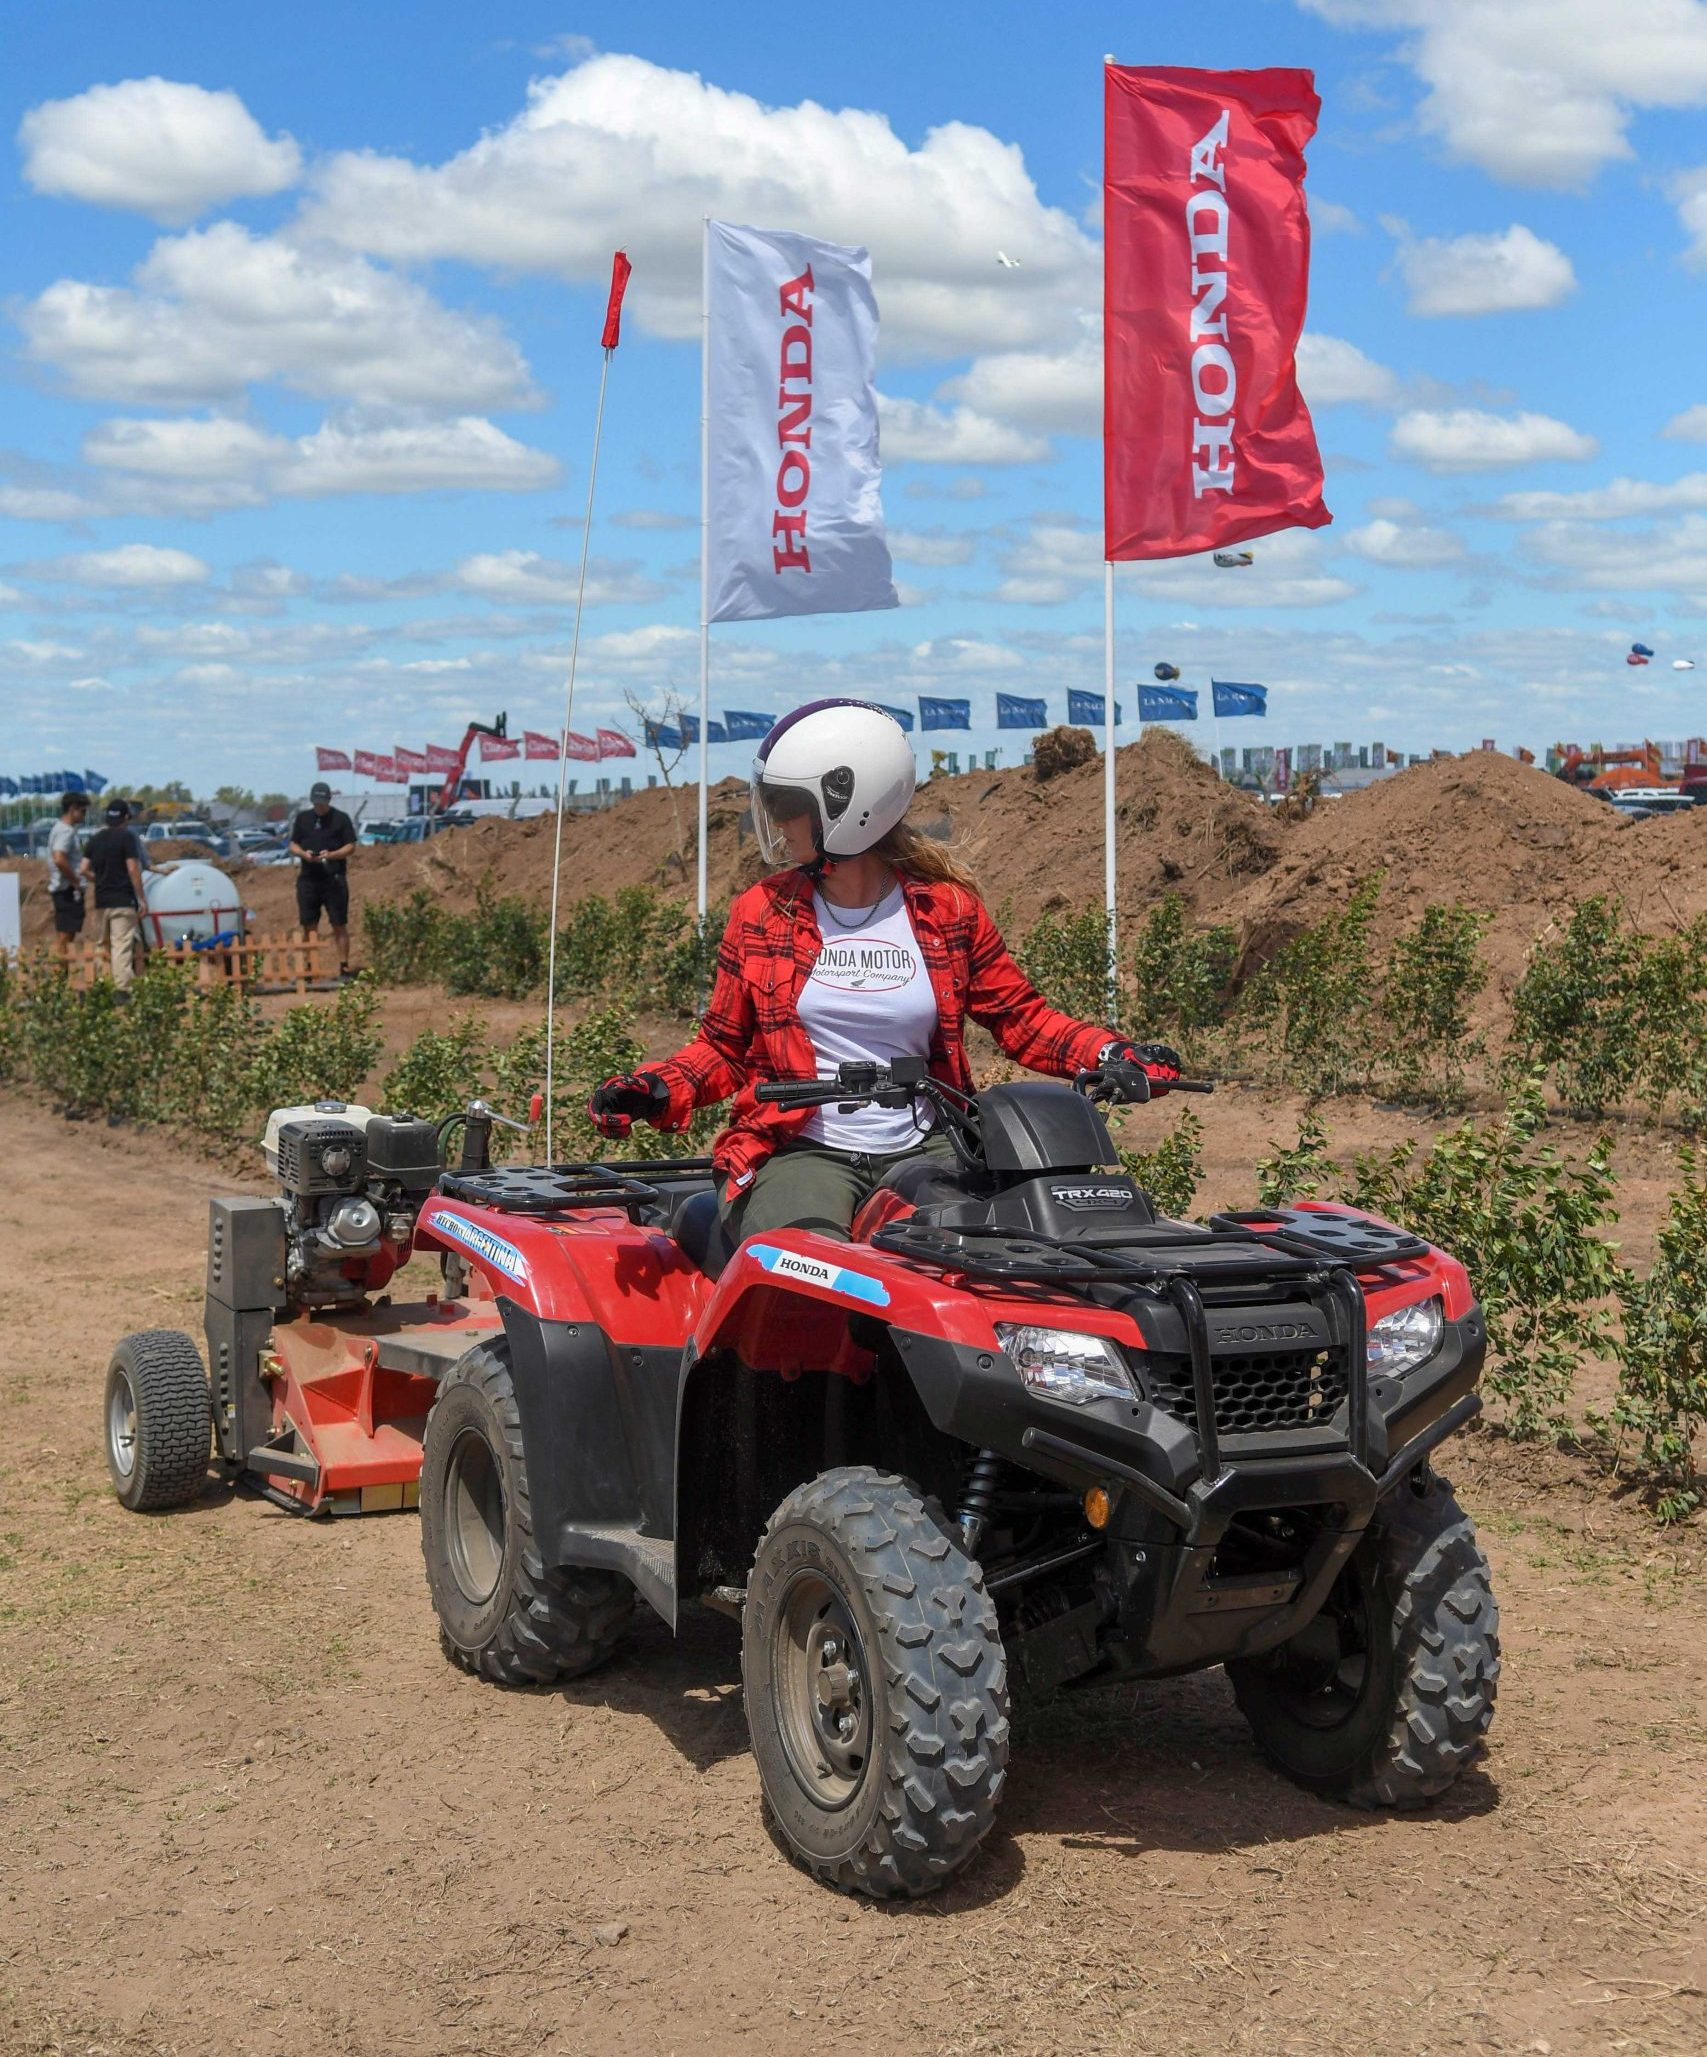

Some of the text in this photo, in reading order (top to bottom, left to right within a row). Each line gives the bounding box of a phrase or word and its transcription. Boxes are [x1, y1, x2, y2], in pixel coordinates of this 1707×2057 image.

[1185, 109, 1237, 499] HONDA
[772, 262, 816, 575] HONDA
[818, 947, 911, 969] ONDA MOTOR
[863, 970, 911, 987] Company
[1052, 1189, 1133, 1200] TRX420
[436, 1214, 459, 1232] HECHO
[463, 1225, 517, 1271] ARGENTINA
[780, 1258, 829, 1280] HONDA
[1214, 1322, 1320, 1344] HONDA
